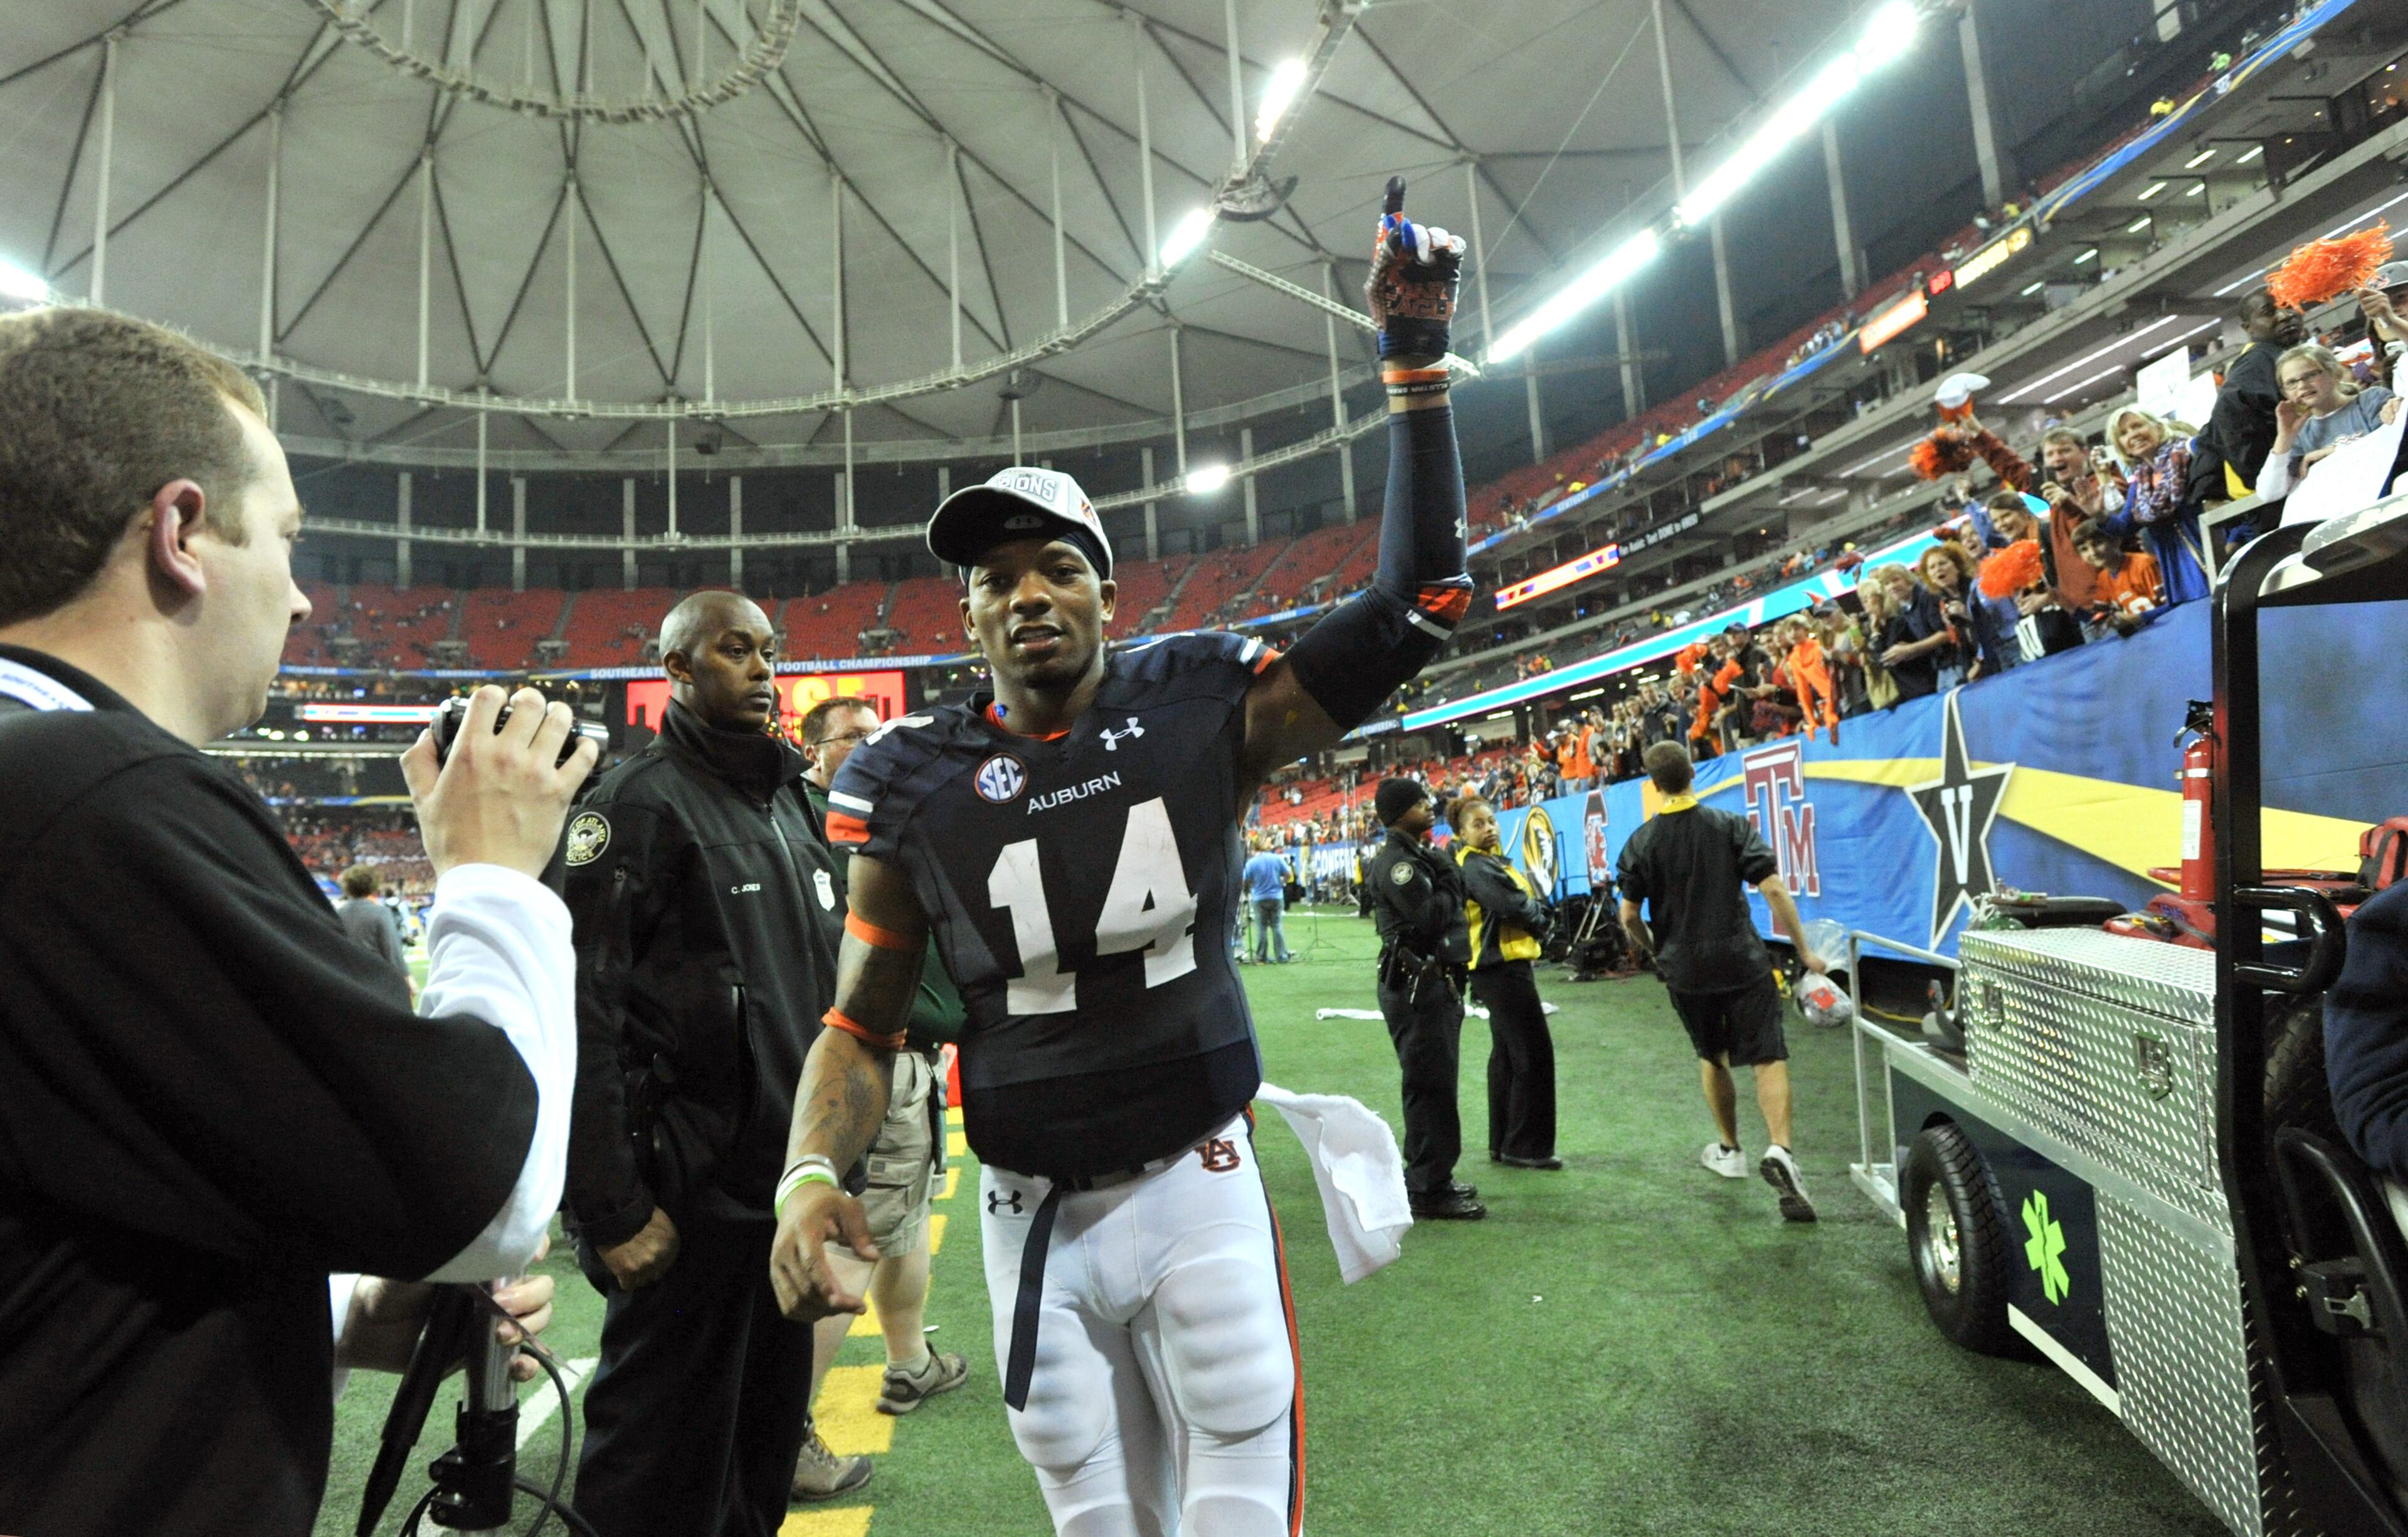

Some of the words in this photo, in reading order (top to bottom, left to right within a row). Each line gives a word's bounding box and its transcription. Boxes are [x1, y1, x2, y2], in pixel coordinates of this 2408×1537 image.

[776, 660, 837, 672] FOOTBALL
[839, 655, 932, 669] CHAMPIONSHIP
[980, 758, 1023, 800] SEC
[1027, 764, 1122, 815] AUBURN
[1941, 784, 1973, 885] V
[741, 883, 761, 892] JONES
[988, 796, 1198, 1015] 14
